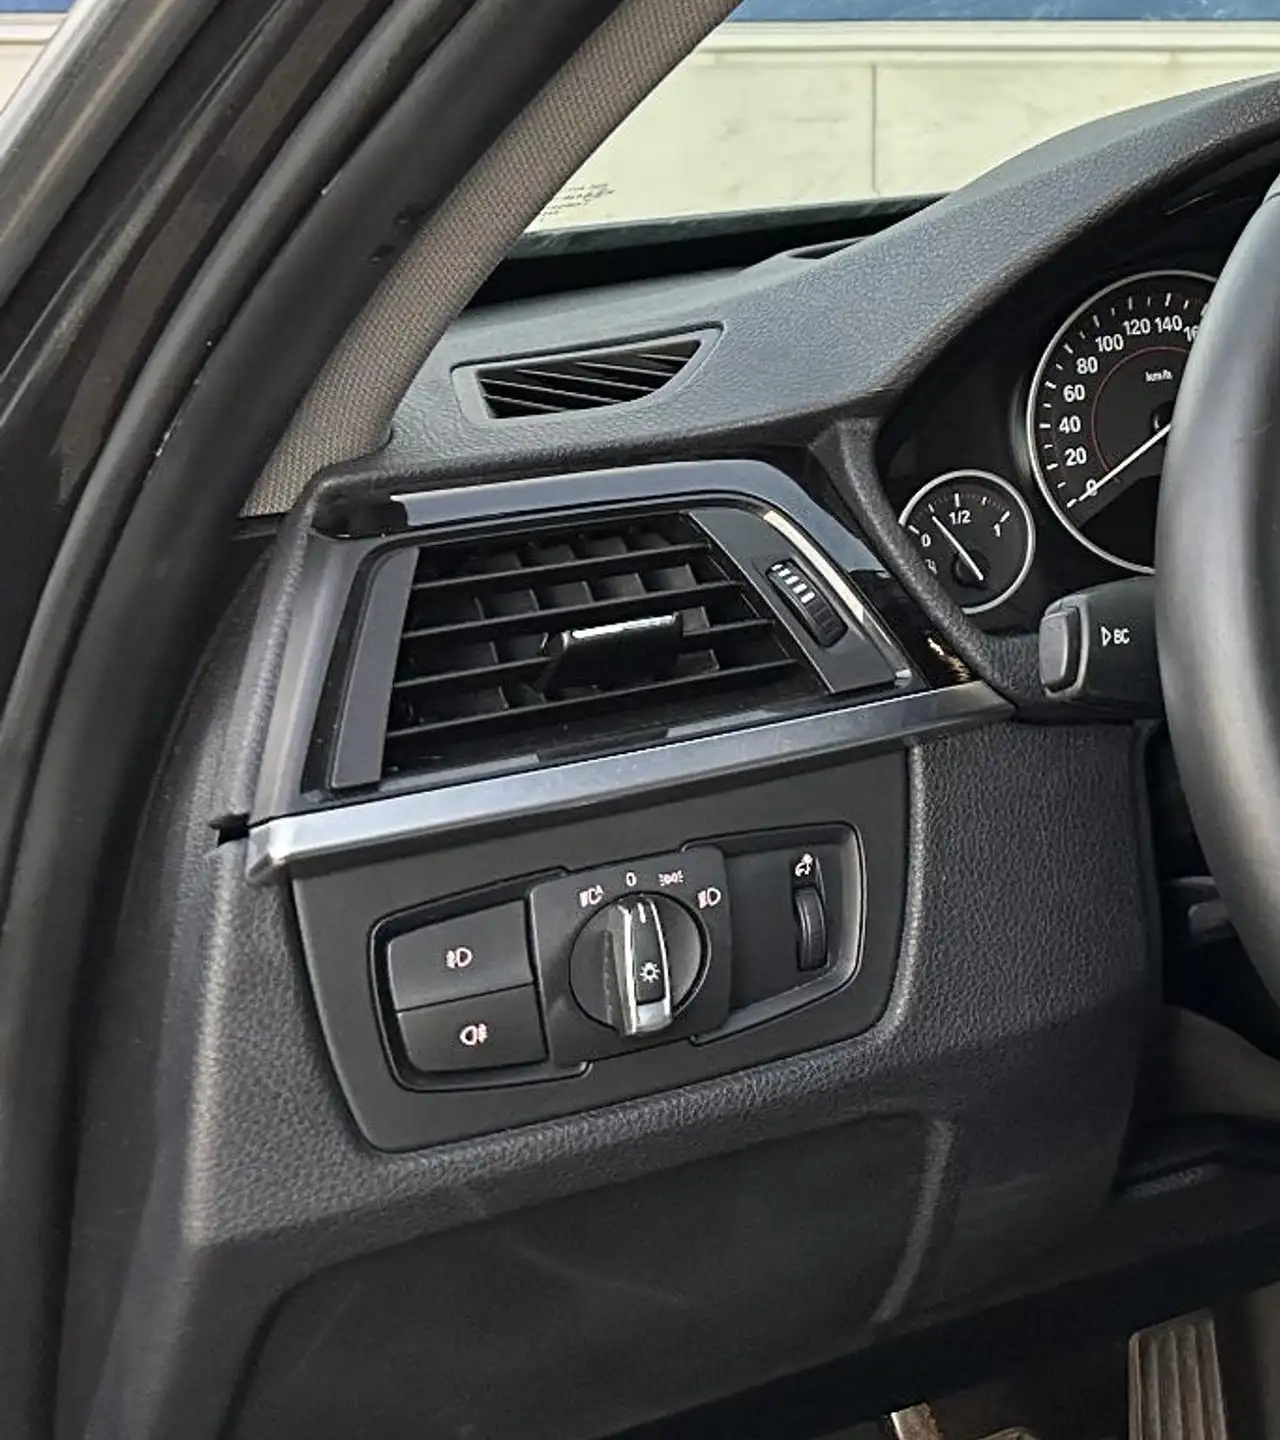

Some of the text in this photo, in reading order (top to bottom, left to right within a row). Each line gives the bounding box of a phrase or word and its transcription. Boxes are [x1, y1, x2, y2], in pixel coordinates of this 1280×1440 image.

[1123, 318, 1151, 335] 120
[1155, 315, 1183, 333] 140
[1095, 334, 1124, 352] 100
[1076, 356, 1098, 374] 80
[1063, 384, 1085, 403] 60
[1059, 416, 1081, 434] 40
[1065, 447, 1087, 466] 20
[949, 510, 973, 525] 1/2
[993, 523, 1001, 537] 1
[921, 534, 932, 547] 0
[1114, 629, 1130, 644] BC
[626, 871, 636, 888] 0
